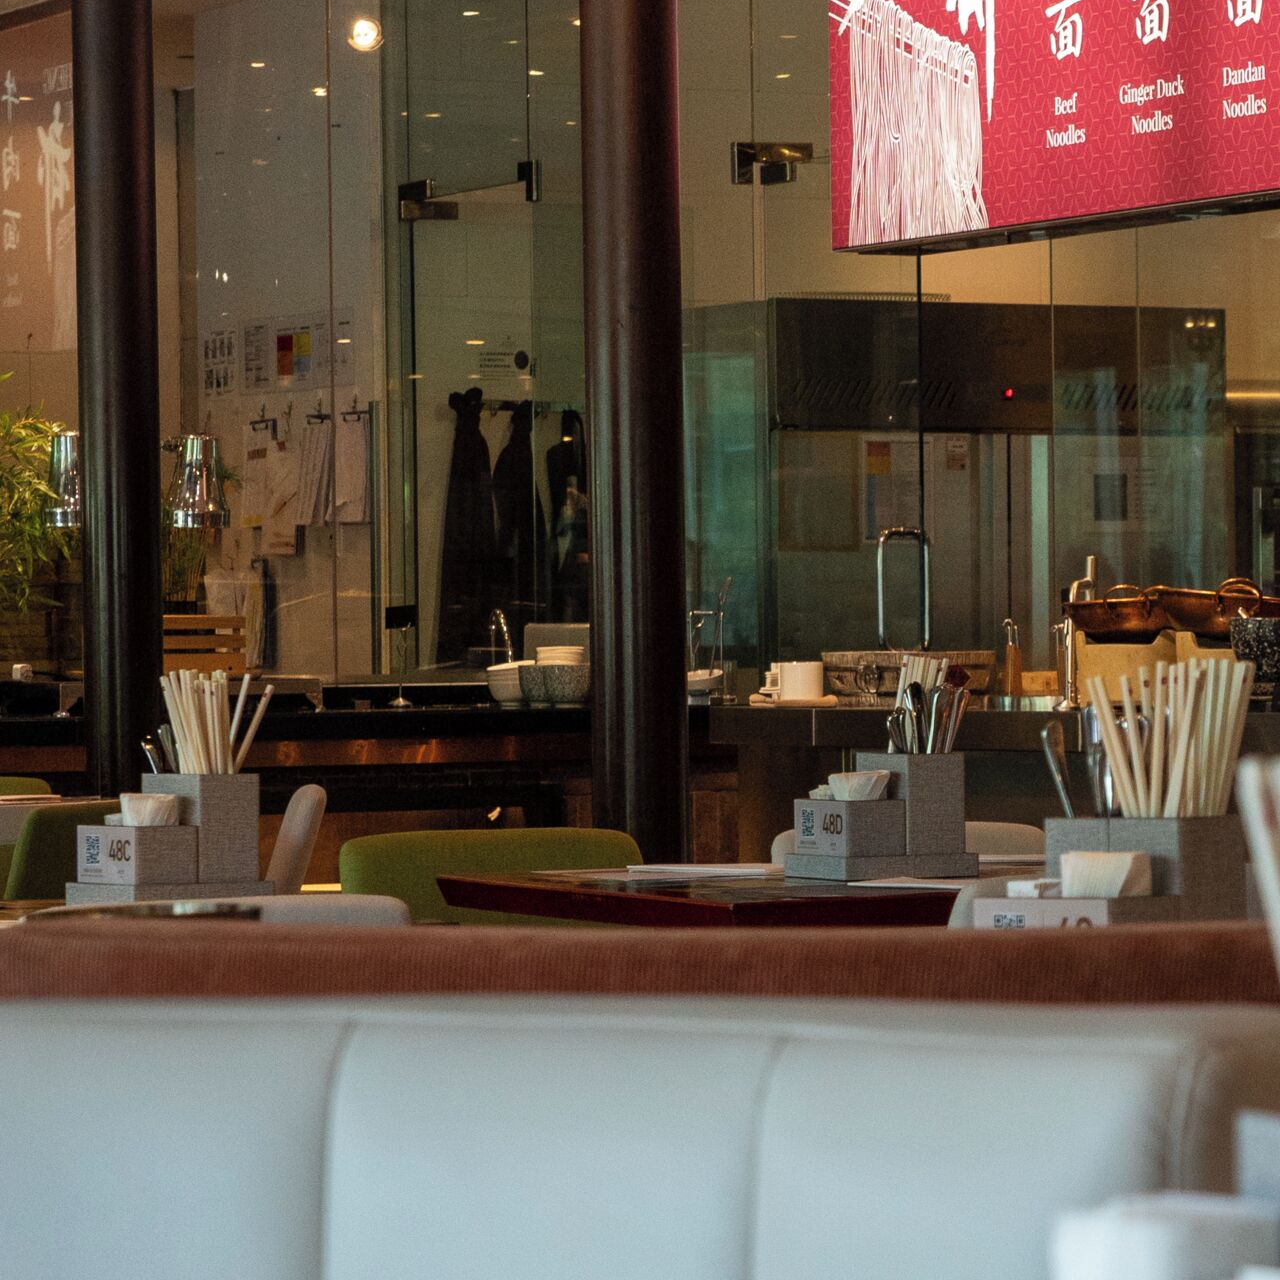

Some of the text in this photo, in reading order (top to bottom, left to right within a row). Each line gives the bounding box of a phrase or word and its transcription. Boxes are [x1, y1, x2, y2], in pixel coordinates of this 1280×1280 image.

[1222, 60, 1266, 86] Dandan
[1118, 73, 1185, 106] Ginger Duck
[1054, 91, 1078, 117] Beef
[1222, 93, 1267, 120] Noodles
[1131, 109, 1173, 135] Noodles
[1045, 124, 1086, 149] Noodles
[823, 814, 843, 835] 48D
[109, 840, 131, 862] 48C
